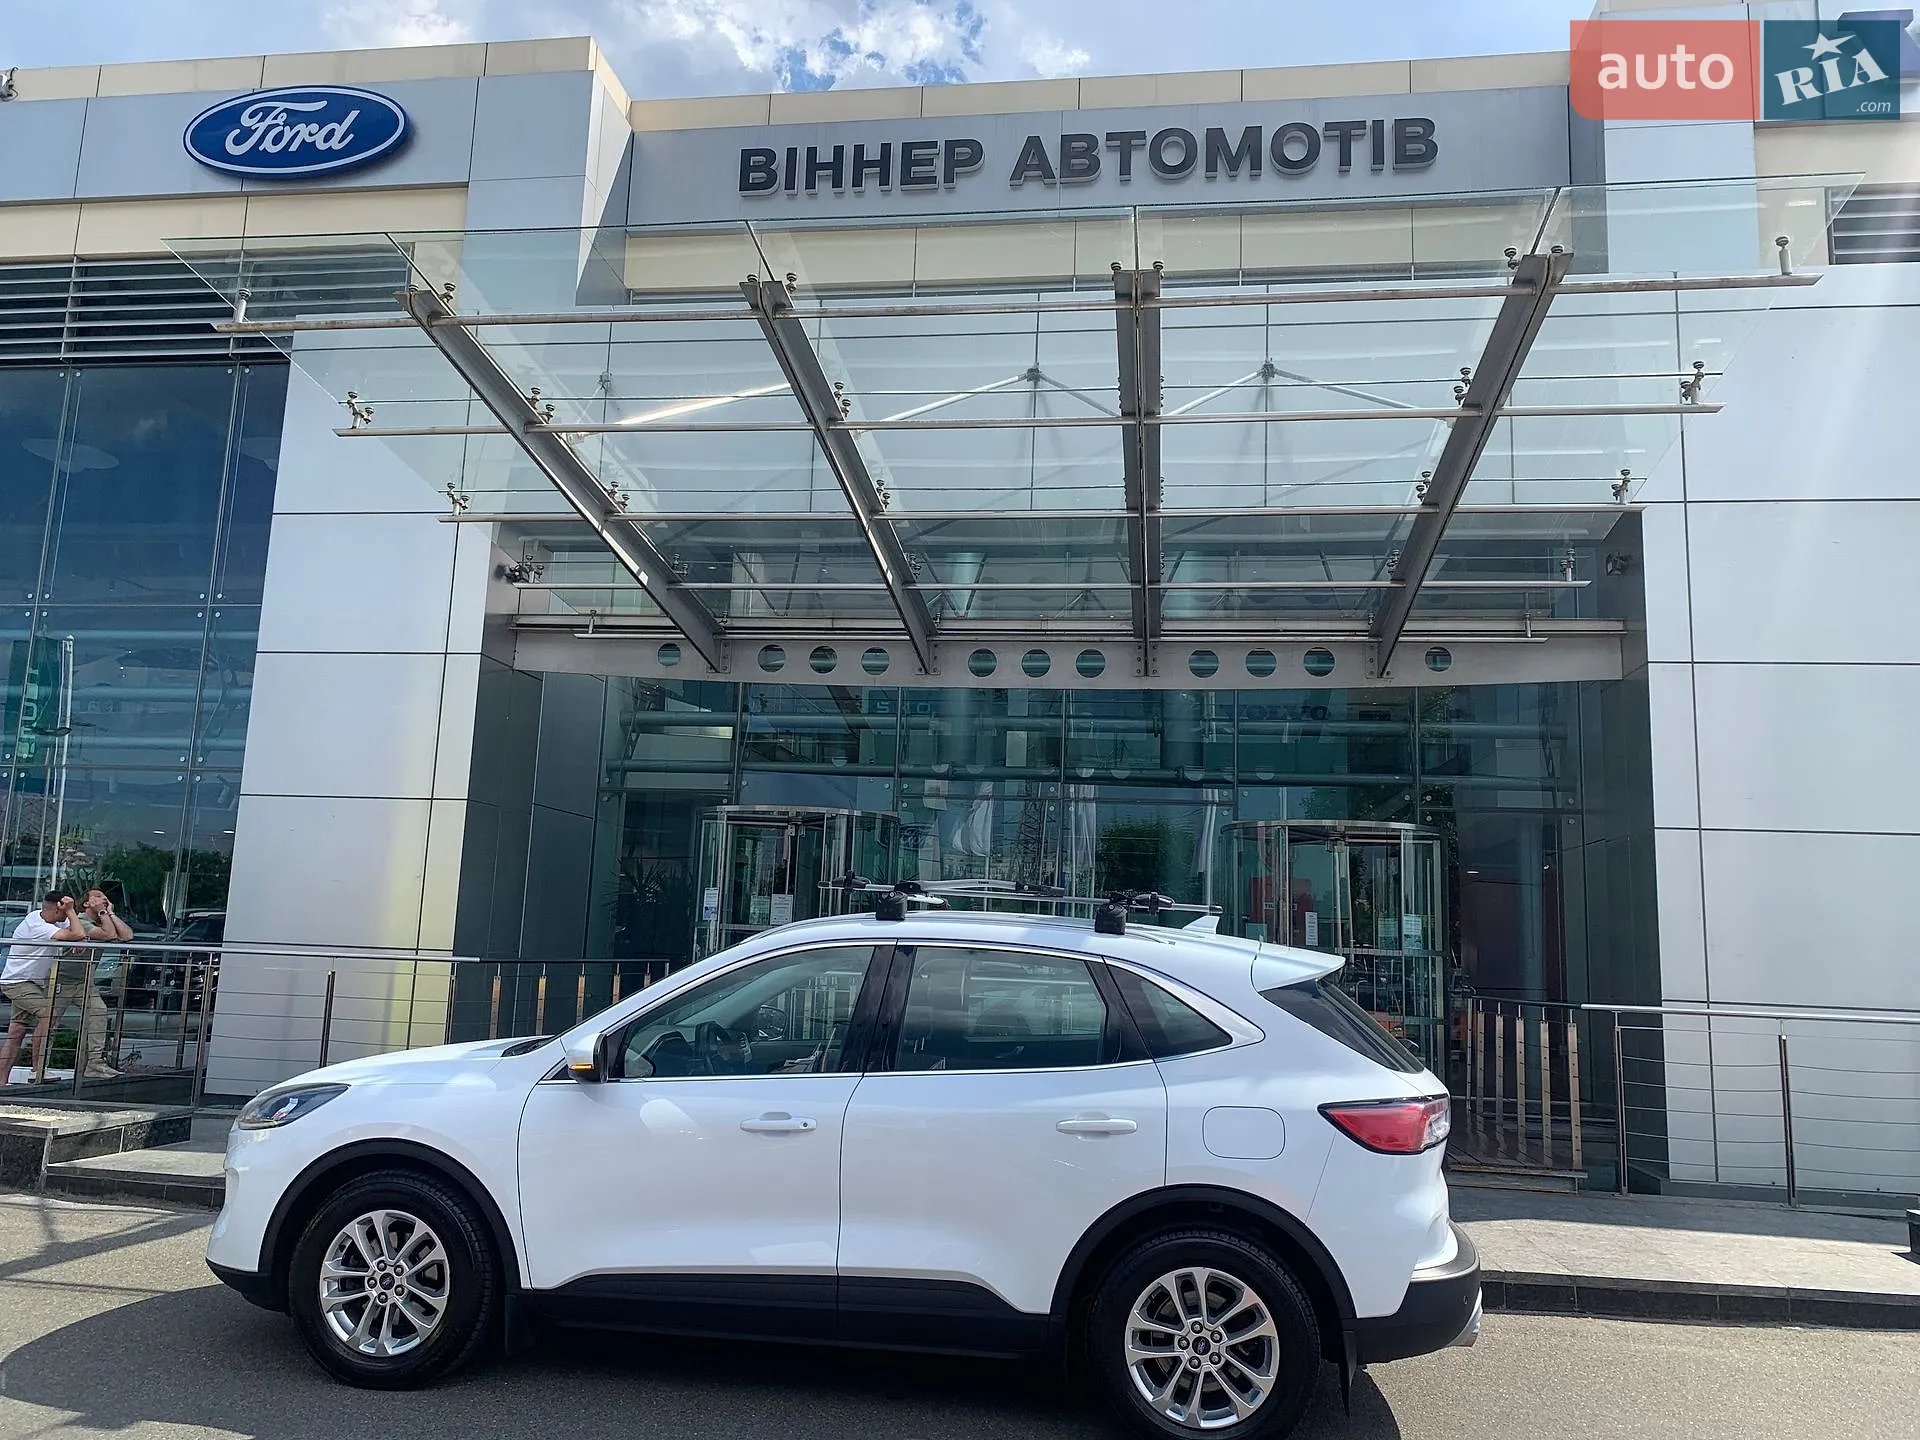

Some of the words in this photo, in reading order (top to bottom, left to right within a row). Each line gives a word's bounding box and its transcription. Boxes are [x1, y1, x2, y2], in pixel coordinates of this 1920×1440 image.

[225, 100, 361, 156] Ford
[738, 139, 985, 197] ВІННЕР
[1008, 118, 1439, 187] АВТОМОТІВ
